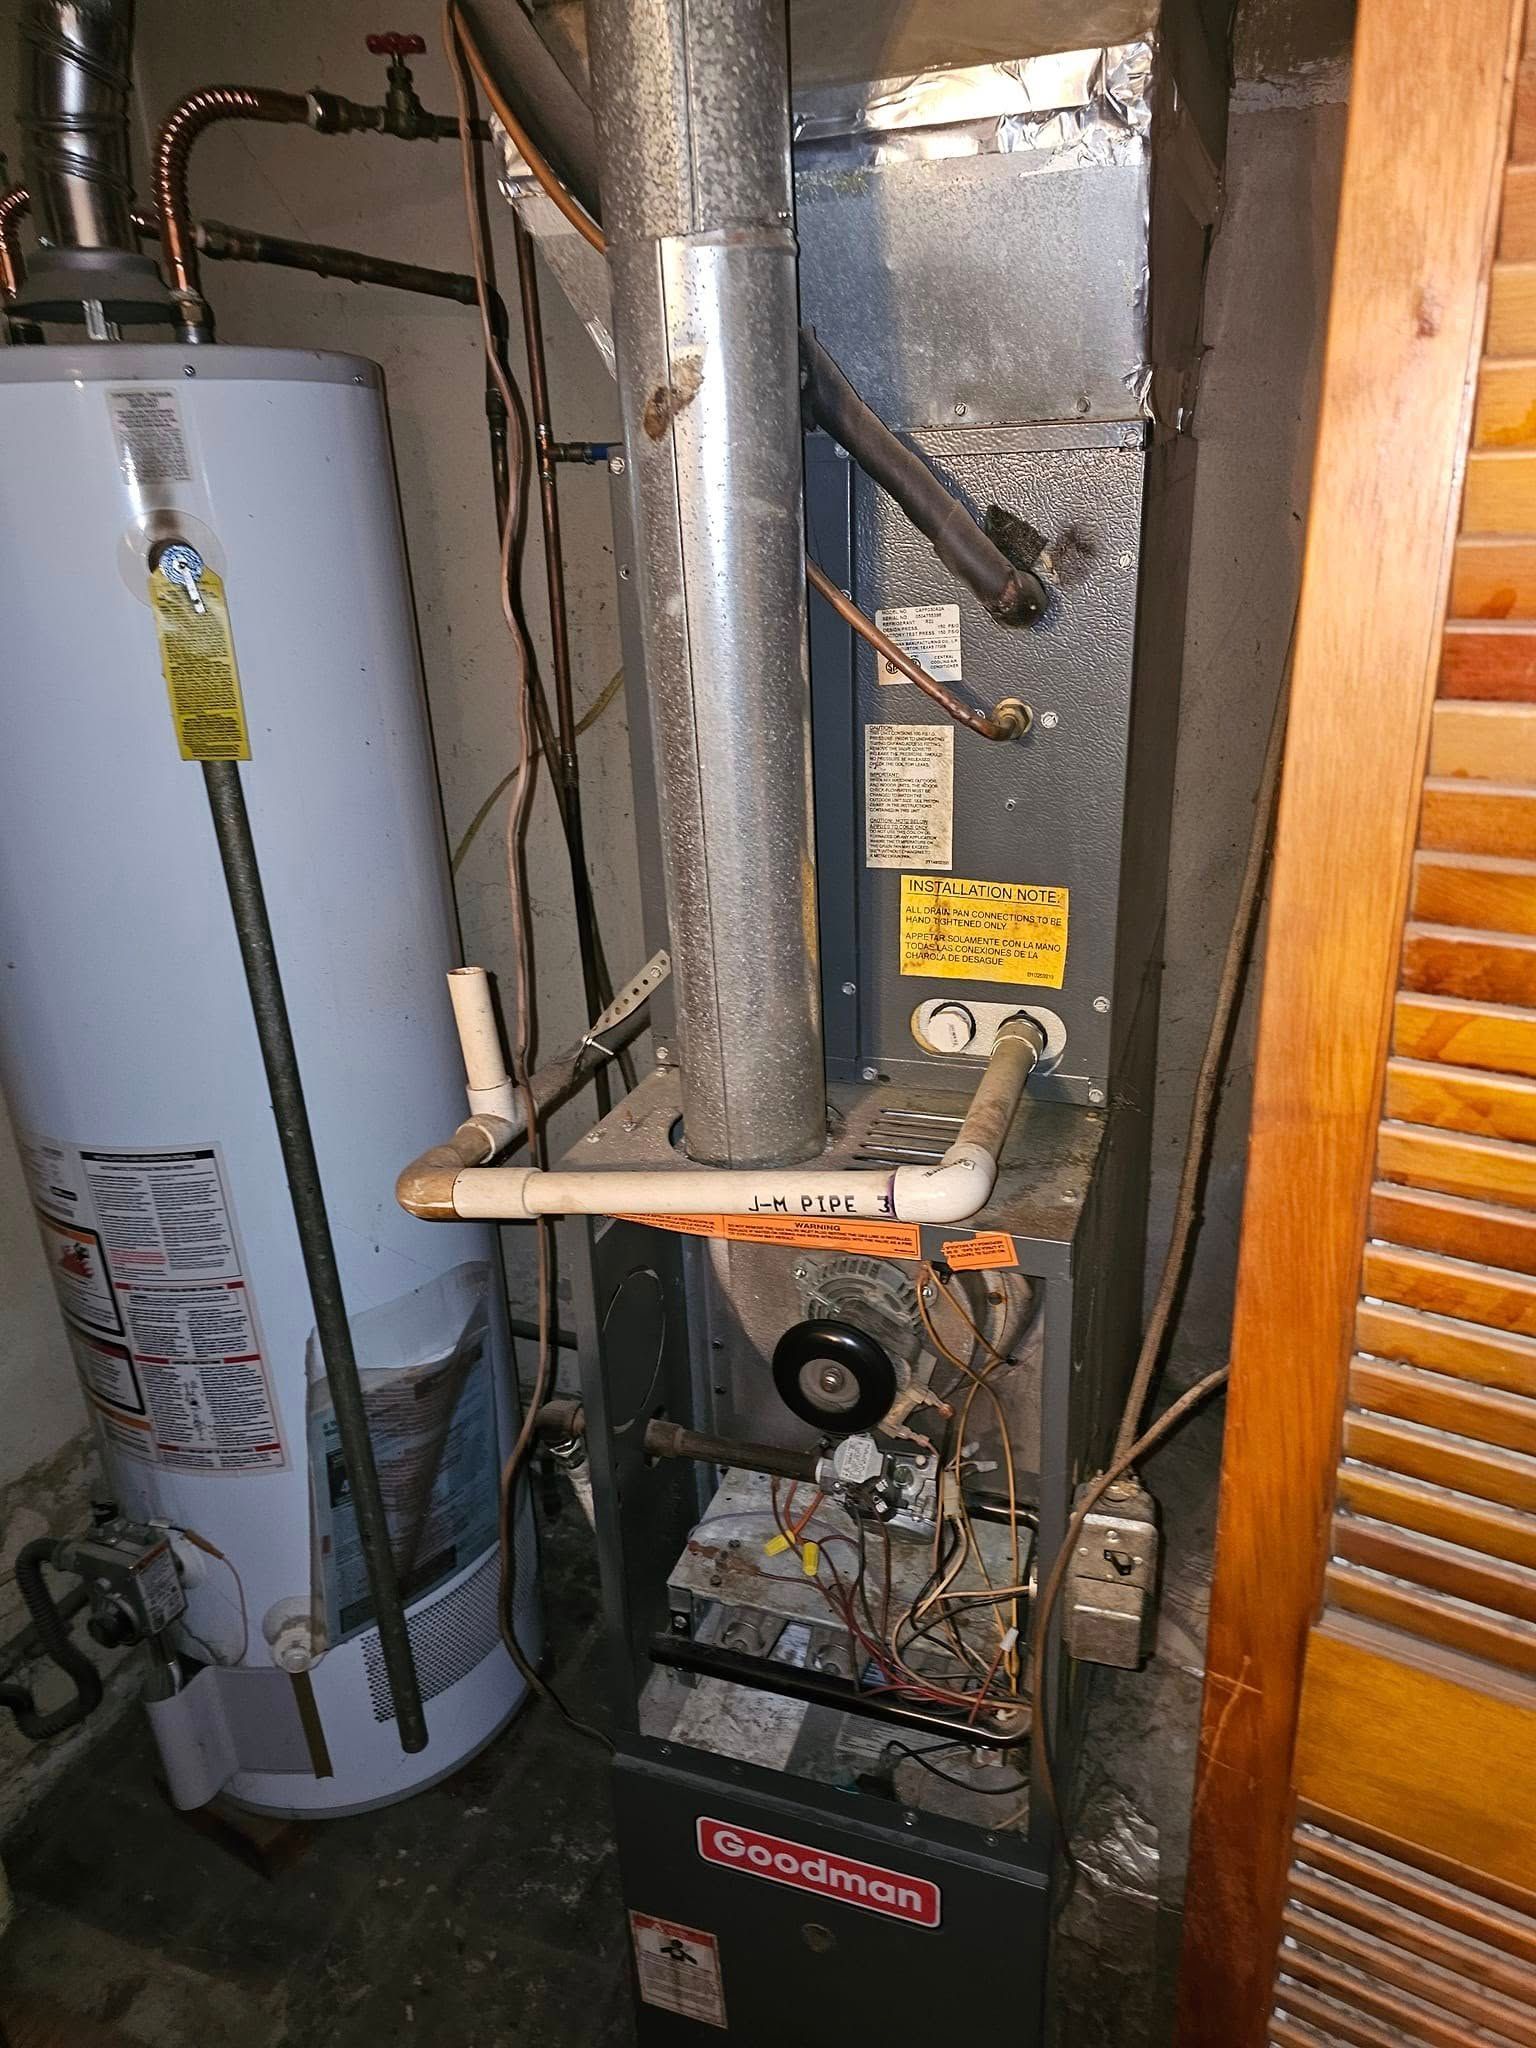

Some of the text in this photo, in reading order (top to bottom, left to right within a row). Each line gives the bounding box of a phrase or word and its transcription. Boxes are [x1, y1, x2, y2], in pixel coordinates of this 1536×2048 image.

[909, 879, 1060, 904] INSTALLATION NOTE:
[906, 906, 1062, 926] ALL DRAIN PAN CONNECTIONS TO BE
[906, 916, 1007, 930] HAND TIGHTENED ONLY
[906, 942, 1038, 959] TODAS LAS CONEXIONES DE LA
[947, 935, 999, 946] SOLAMENTE
[1002, 939, 1021, 948] CON
[1024, 941, 1034, 949] LA
[1035, 943, 1061, 952] MANO
[906, 952, 1004, 966] CHAROLA DE DESAGUE
[749, 1195, 788, 1213] J-M
[801, 1195, 857, 1213] PIPE
[794, 1222, 841, 1232] WARNING
[713, 1830, 922, 1912] Goodman
